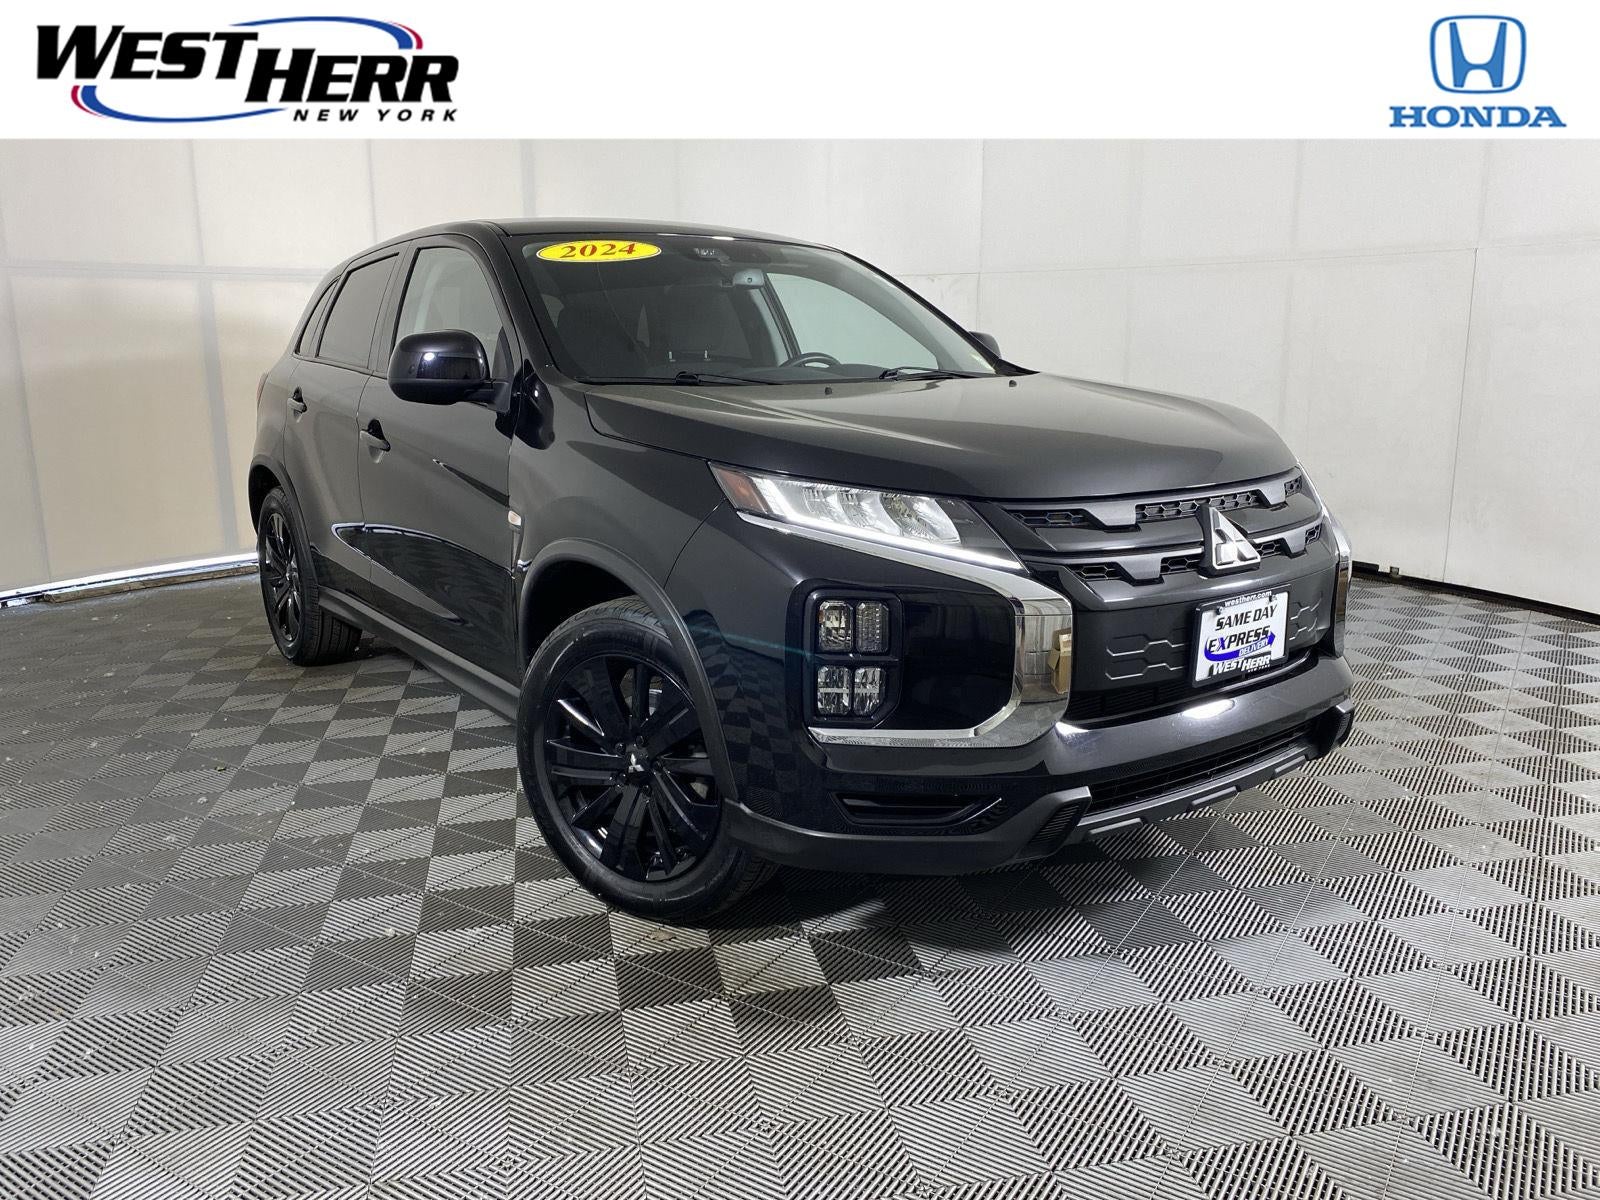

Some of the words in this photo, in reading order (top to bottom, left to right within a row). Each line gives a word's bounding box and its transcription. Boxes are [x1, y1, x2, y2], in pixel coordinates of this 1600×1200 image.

[561, 244, 636, 258] 2024
[1224, 592, 1272, 607] westherr.com
[1215, 611, 1252, 631] SAME
[1252, 604, 1277, 619] DAY
[1208, 625, 1271, 653] EXPRESS
[1239, 639, 1269, 655] DELIVERY
